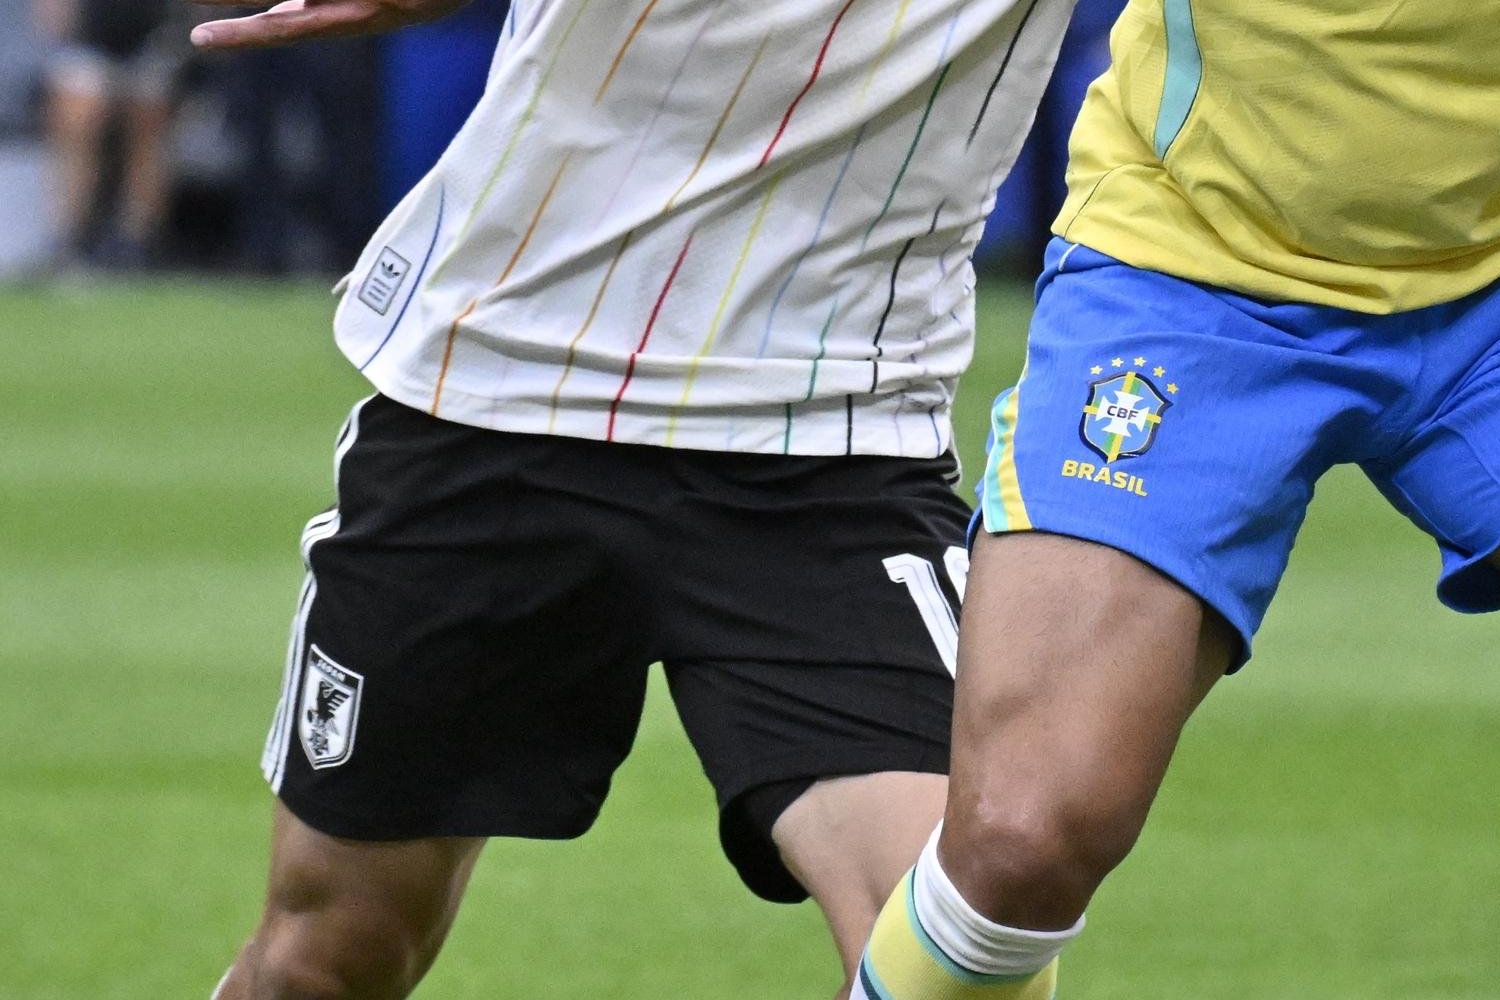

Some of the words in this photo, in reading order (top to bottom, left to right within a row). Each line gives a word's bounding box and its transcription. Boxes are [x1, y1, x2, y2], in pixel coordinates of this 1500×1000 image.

[1106, 405, 1139, 421] CBF
[1061, 459, 1148, 497] BRASIL
[881, 545, 970, 680] 1
